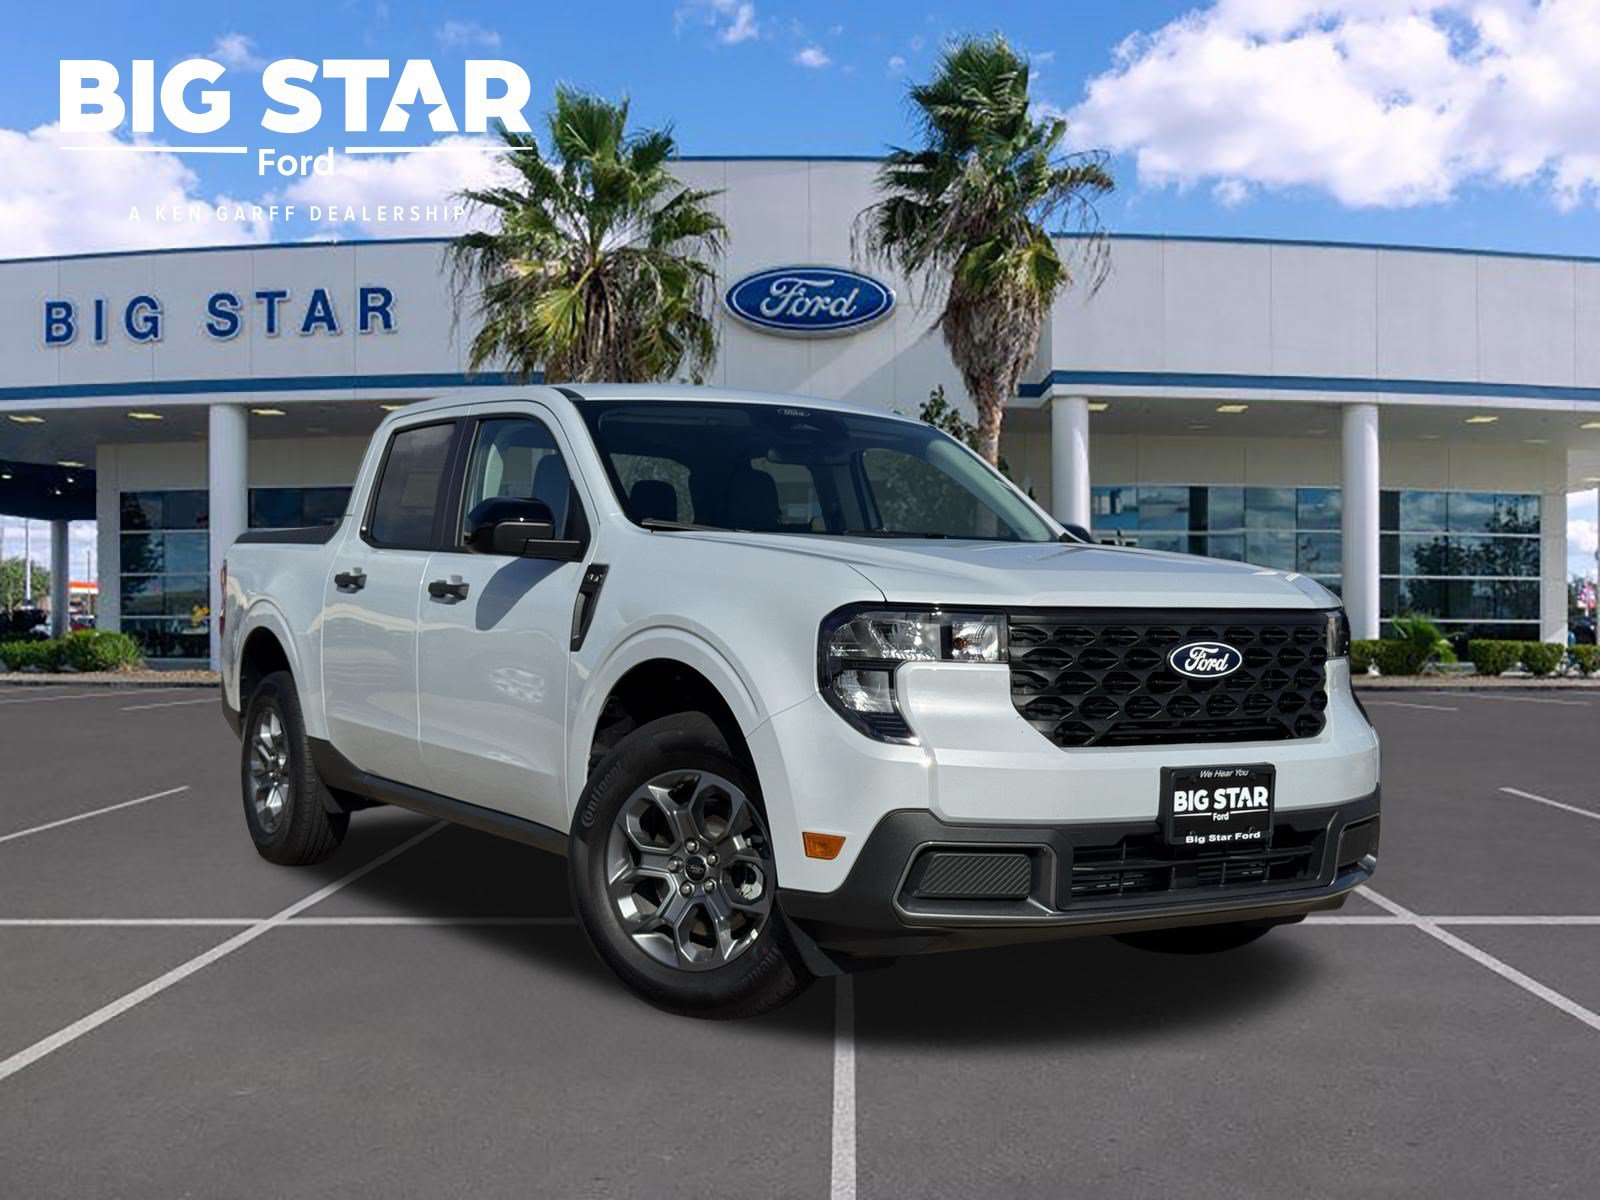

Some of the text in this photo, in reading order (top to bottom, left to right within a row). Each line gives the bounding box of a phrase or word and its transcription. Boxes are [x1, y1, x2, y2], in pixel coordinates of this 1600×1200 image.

[760, 277, 860, 318] Ford
[44, 286, 399, 346] BIG STAR
[1184, 646, 1230, 672] Ford
[1200, 768, 1250, 779] We Hear You
[1173, 786, 1269, 813] BIG STAR
[1212, 812, 1230, 822] Ford
[1185, 831, 1261, 844] Big Star Ford
